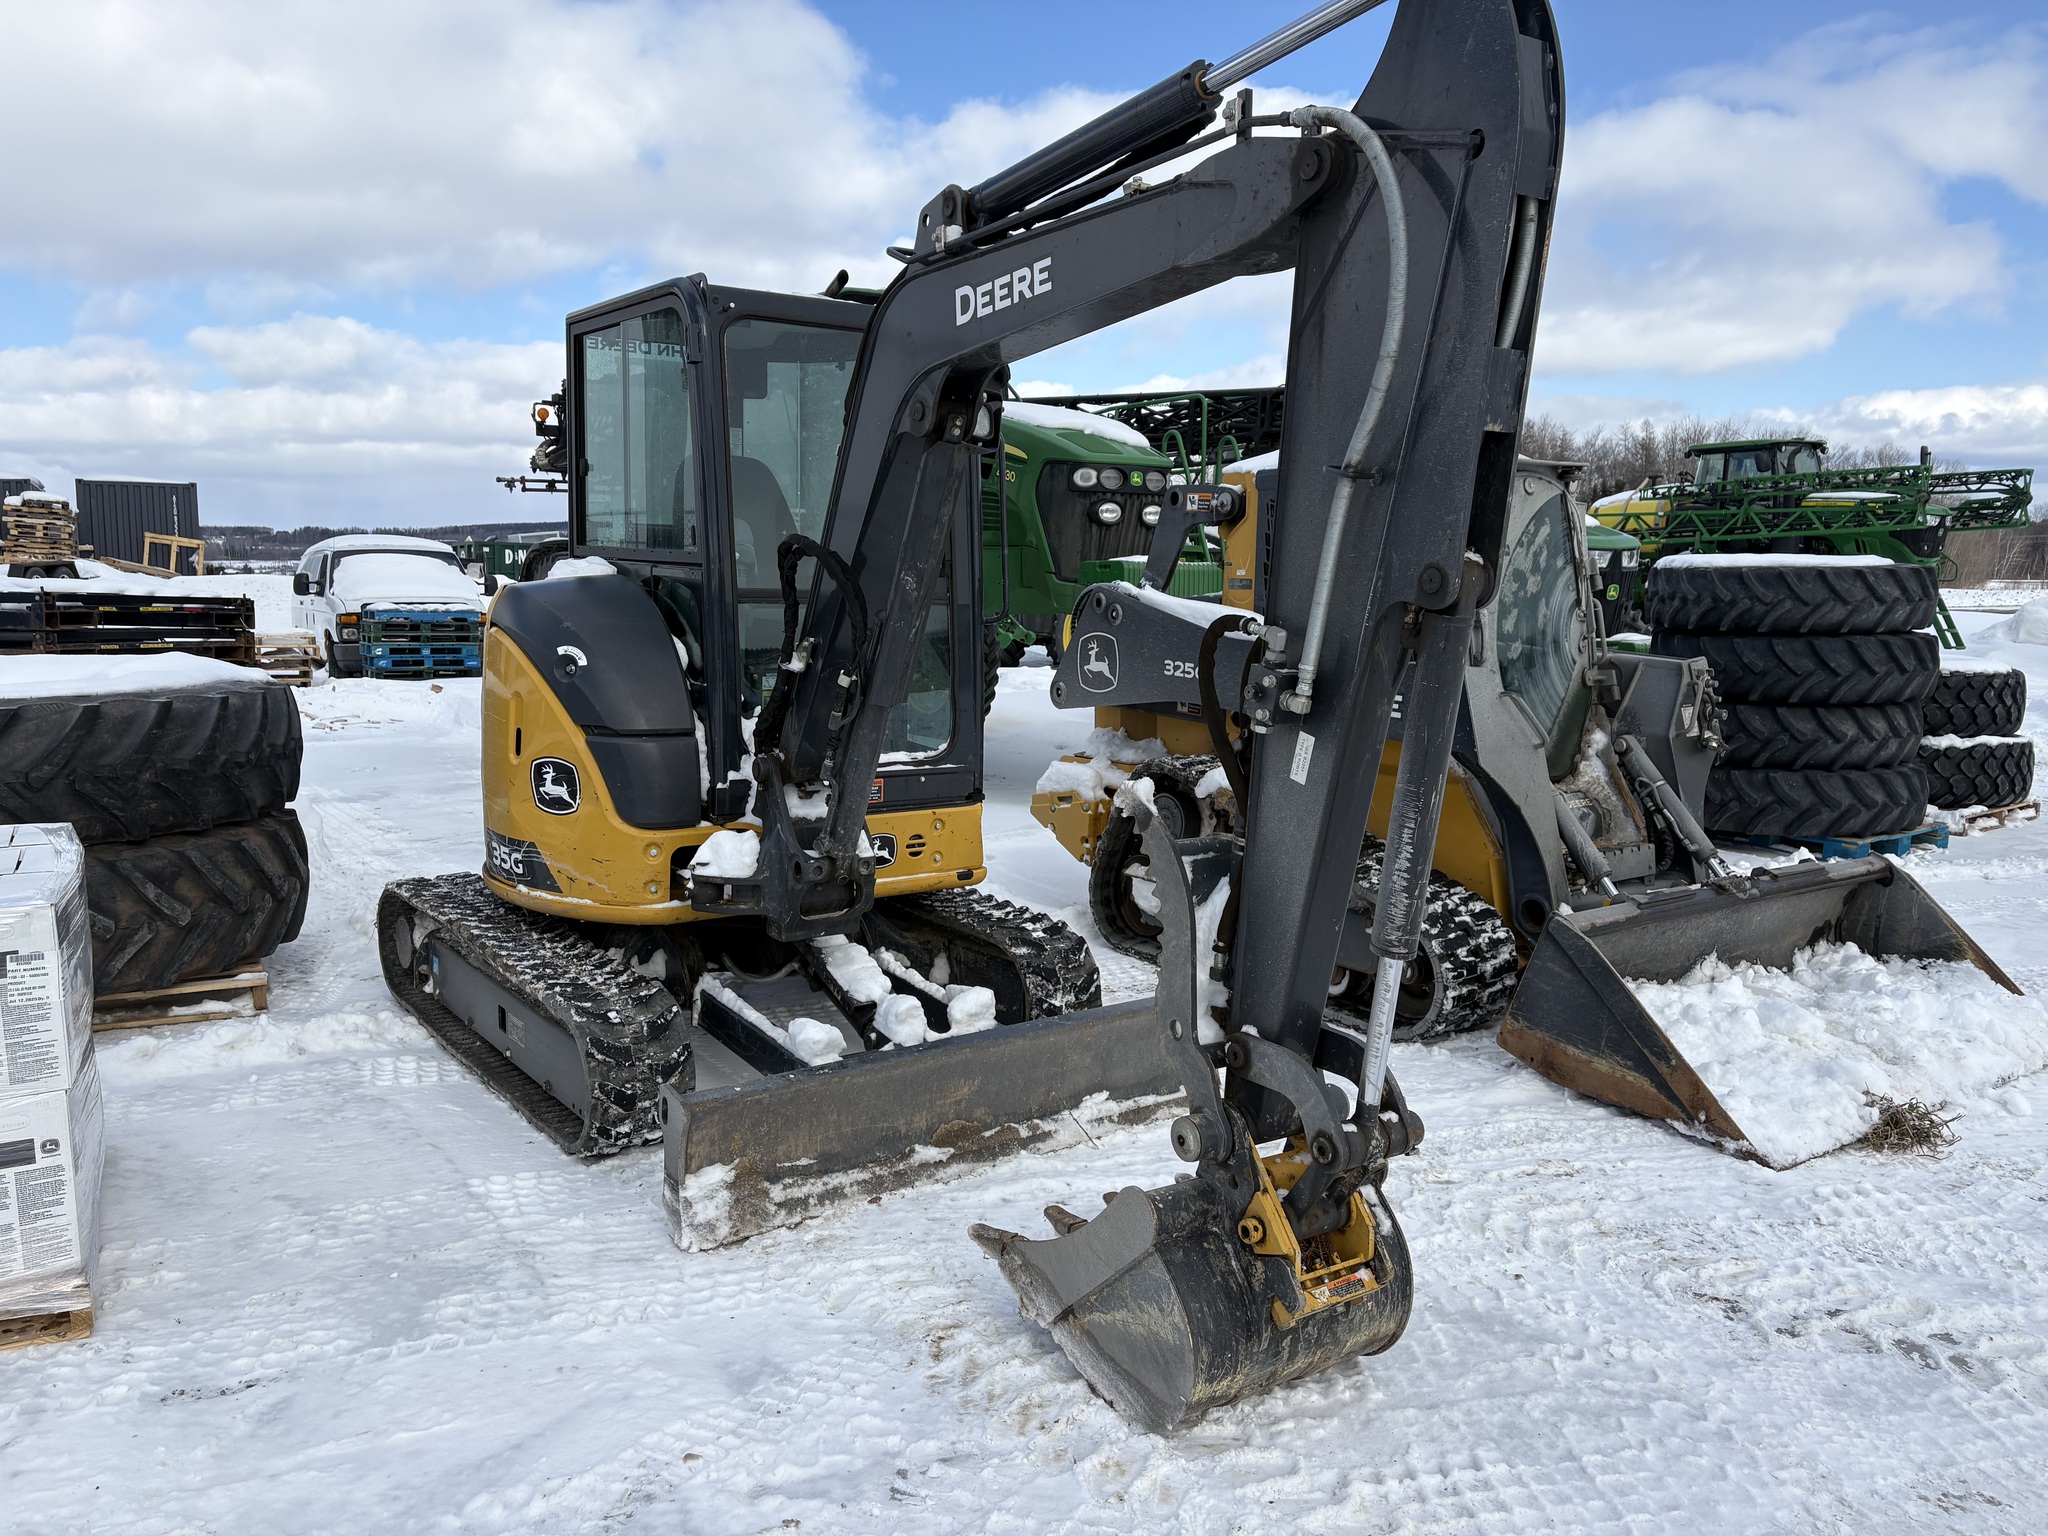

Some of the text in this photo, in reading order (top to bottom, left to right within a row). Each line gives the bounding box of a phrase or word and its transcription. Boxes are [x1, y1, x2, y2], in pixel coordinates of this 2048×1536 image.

[955, 256, 1052, 326] DEERE
[996, 469, 1016, 483] 430
[491, 840, 524, 874] 35G
